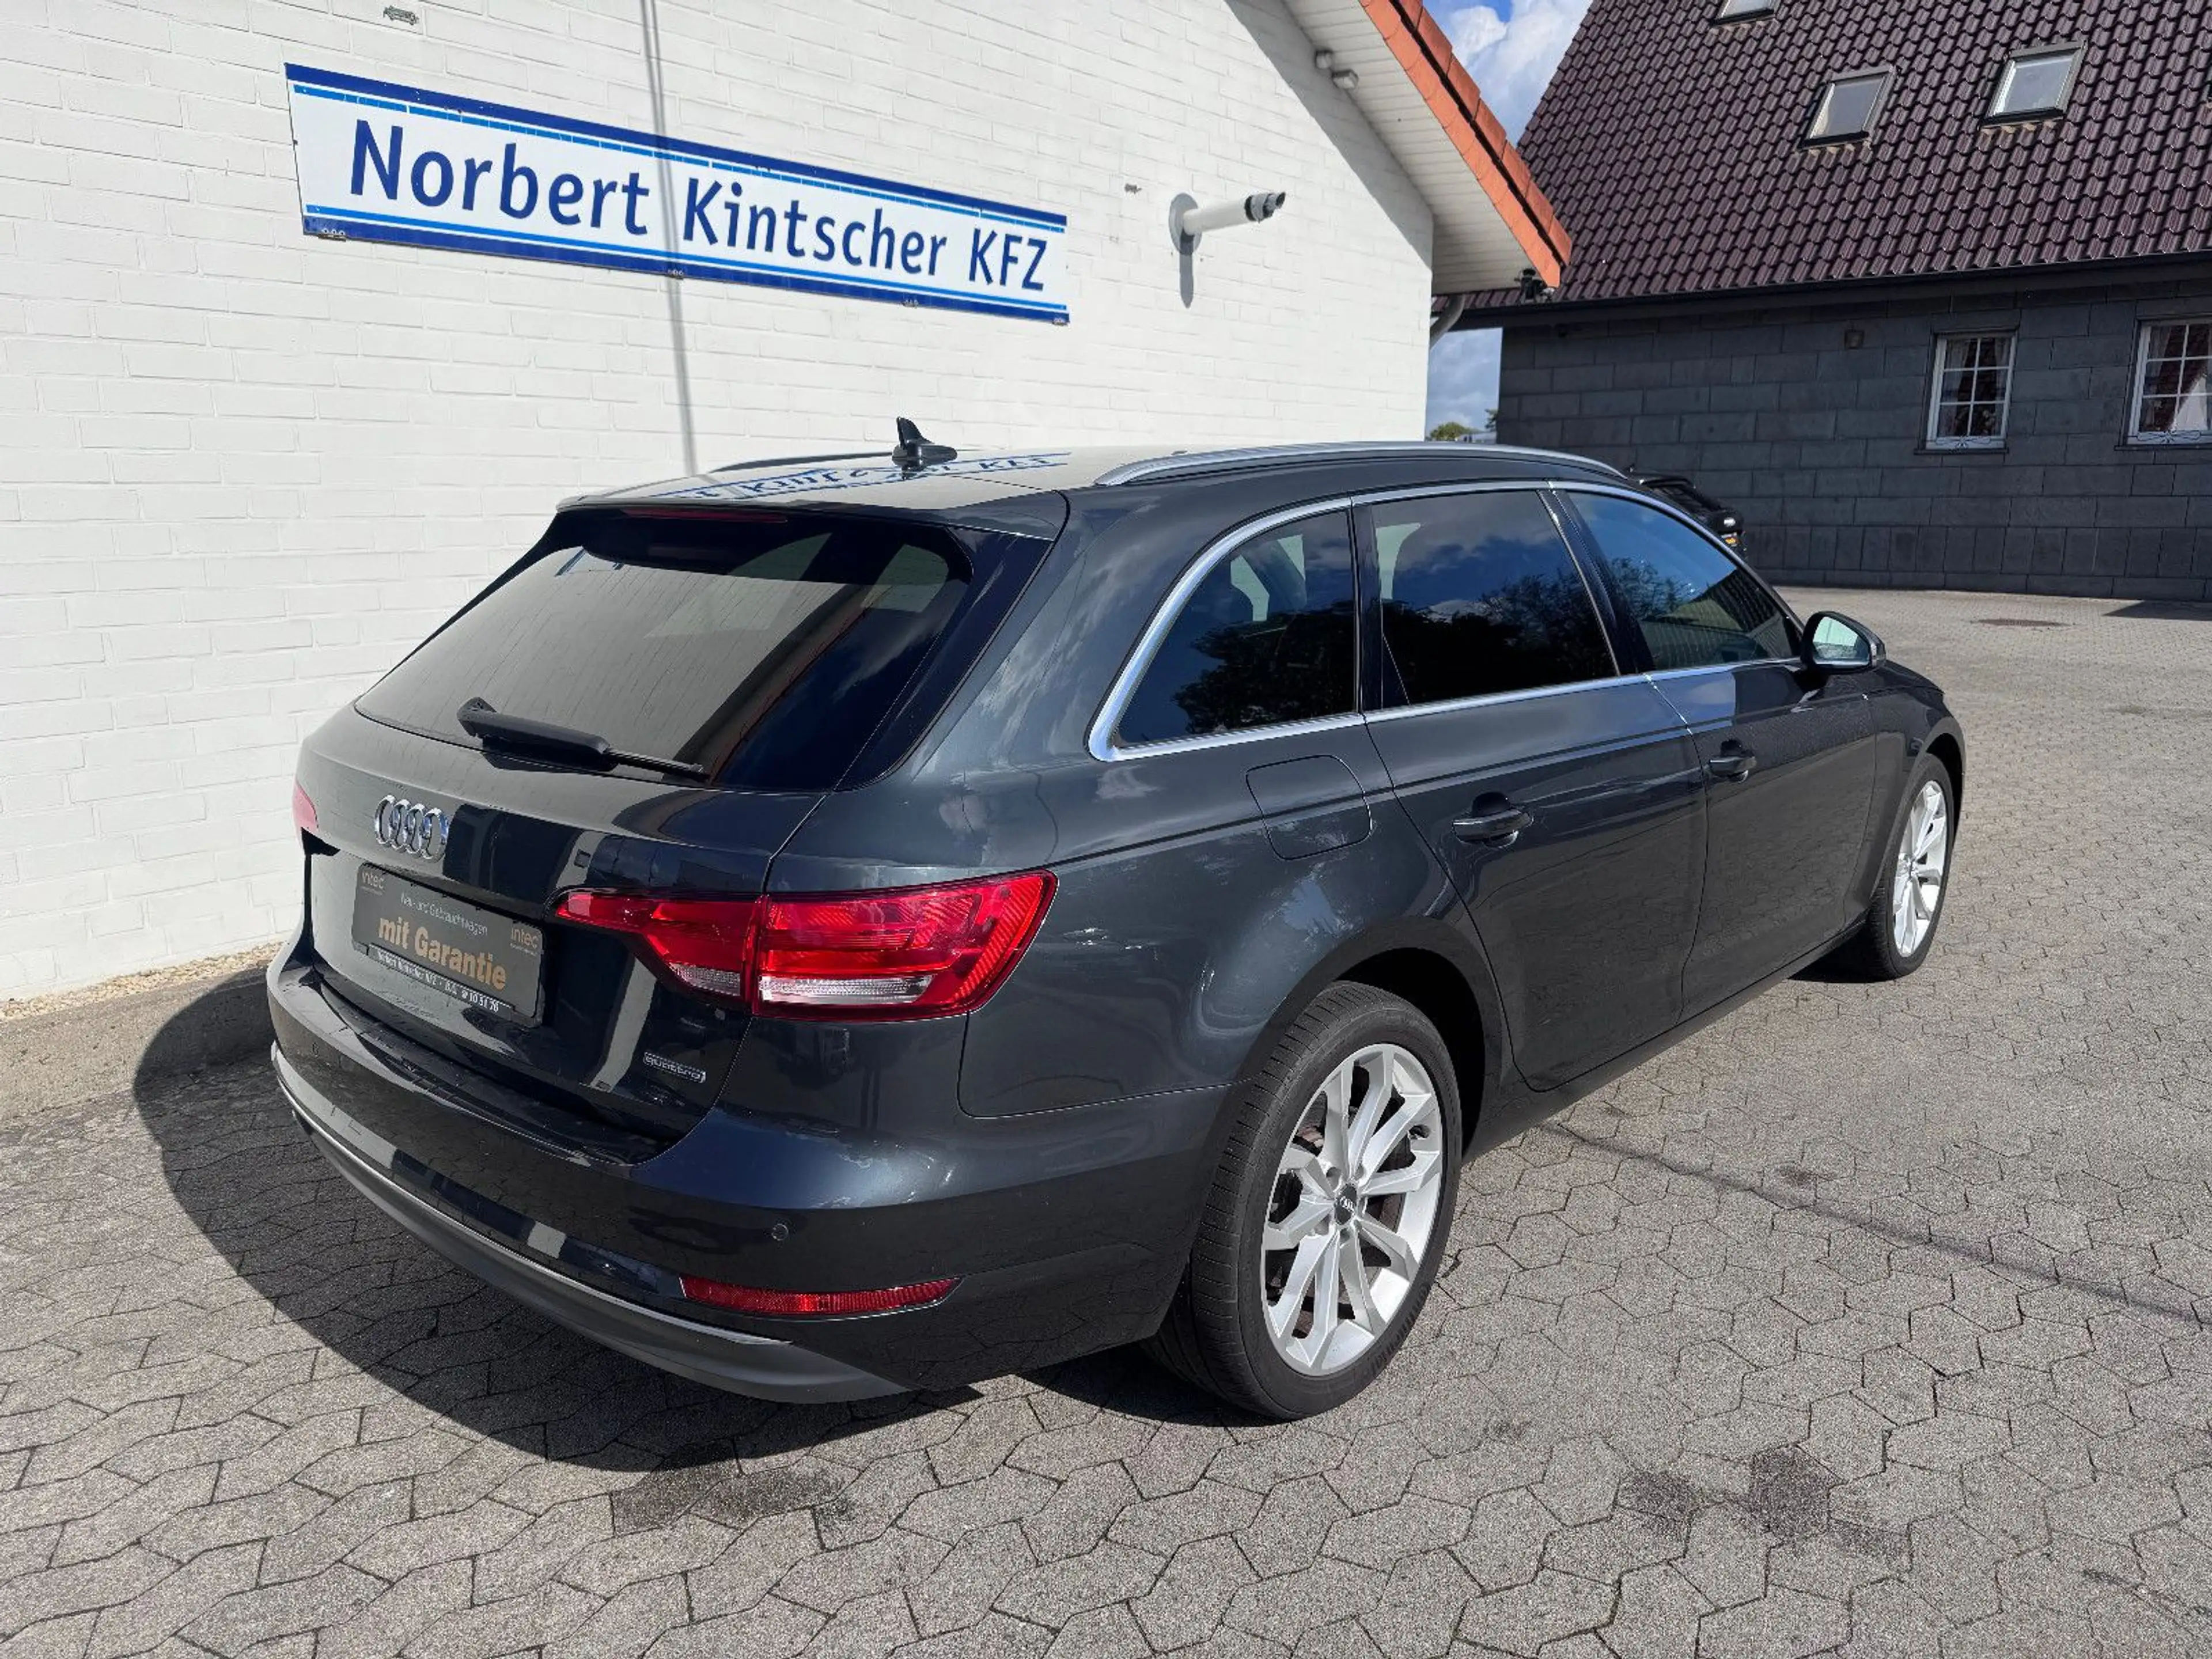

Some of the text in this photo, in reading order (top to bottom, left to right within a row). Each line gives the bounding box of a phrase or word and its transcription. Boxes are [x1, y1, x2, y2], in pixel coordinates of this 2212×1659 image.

[351, 119, 1048, 291] Norbert Kintscher KFZ
[378, 916, 410, 950] mit
[415, 926, 506, 991] Garantie
